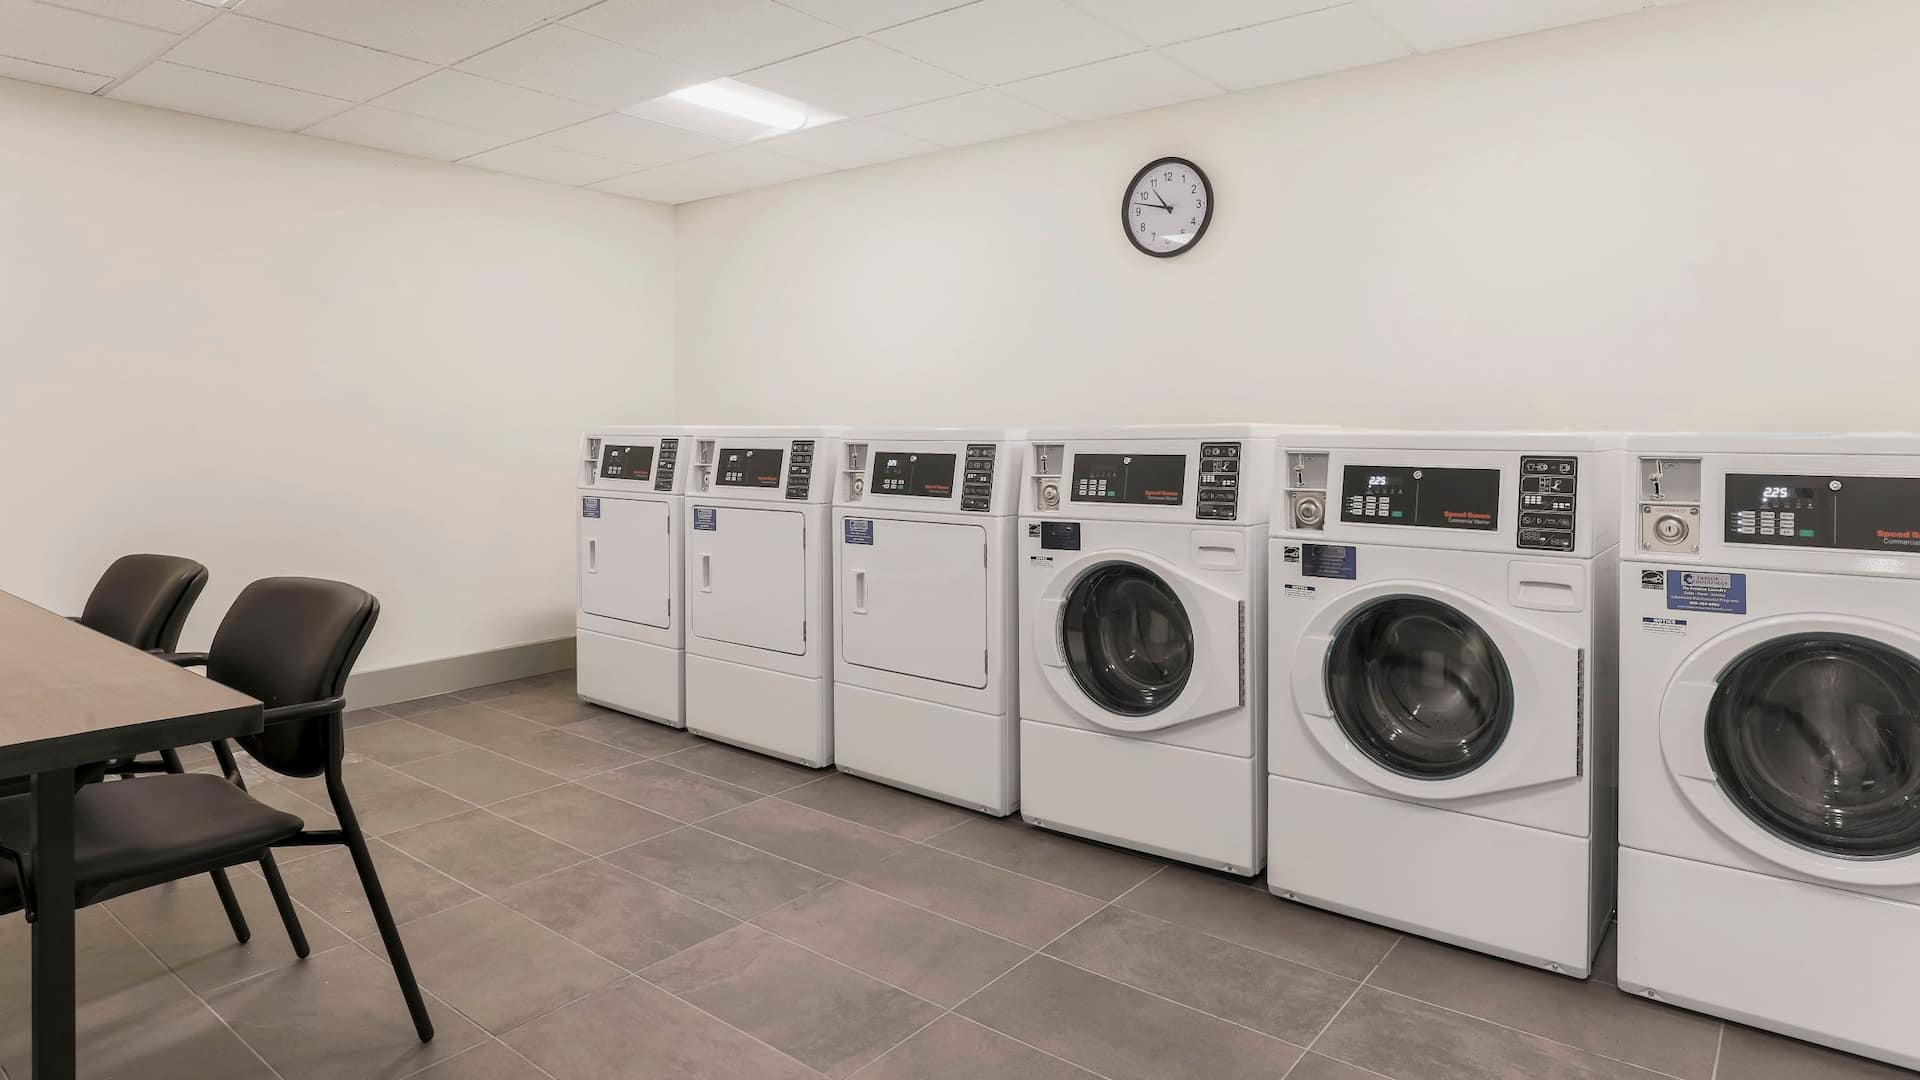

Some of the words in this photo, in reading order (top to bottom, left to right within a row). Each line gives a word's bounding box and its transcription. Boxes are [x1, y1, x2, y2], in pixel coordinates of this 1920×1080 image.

[1163, 171, 1173, 182] 12
[1181, 174, 1186, 183] 1
[1150, 178, 1158, 188] 11
[1191, 184, 1197, 194] 2
[1139, 191, 1149, 201] 10
[1195, 199, 1202, 209] 3
[1135, 207, 1142, 217] 9
[1190, 216, 1196, 226] 4
[1140, 222, 1146, 232] 8
[1151, 232, 1157, 241] 7
[1876, 529, 1910, 539] Speed
[1883, 537, 1920, 546] Commercia
